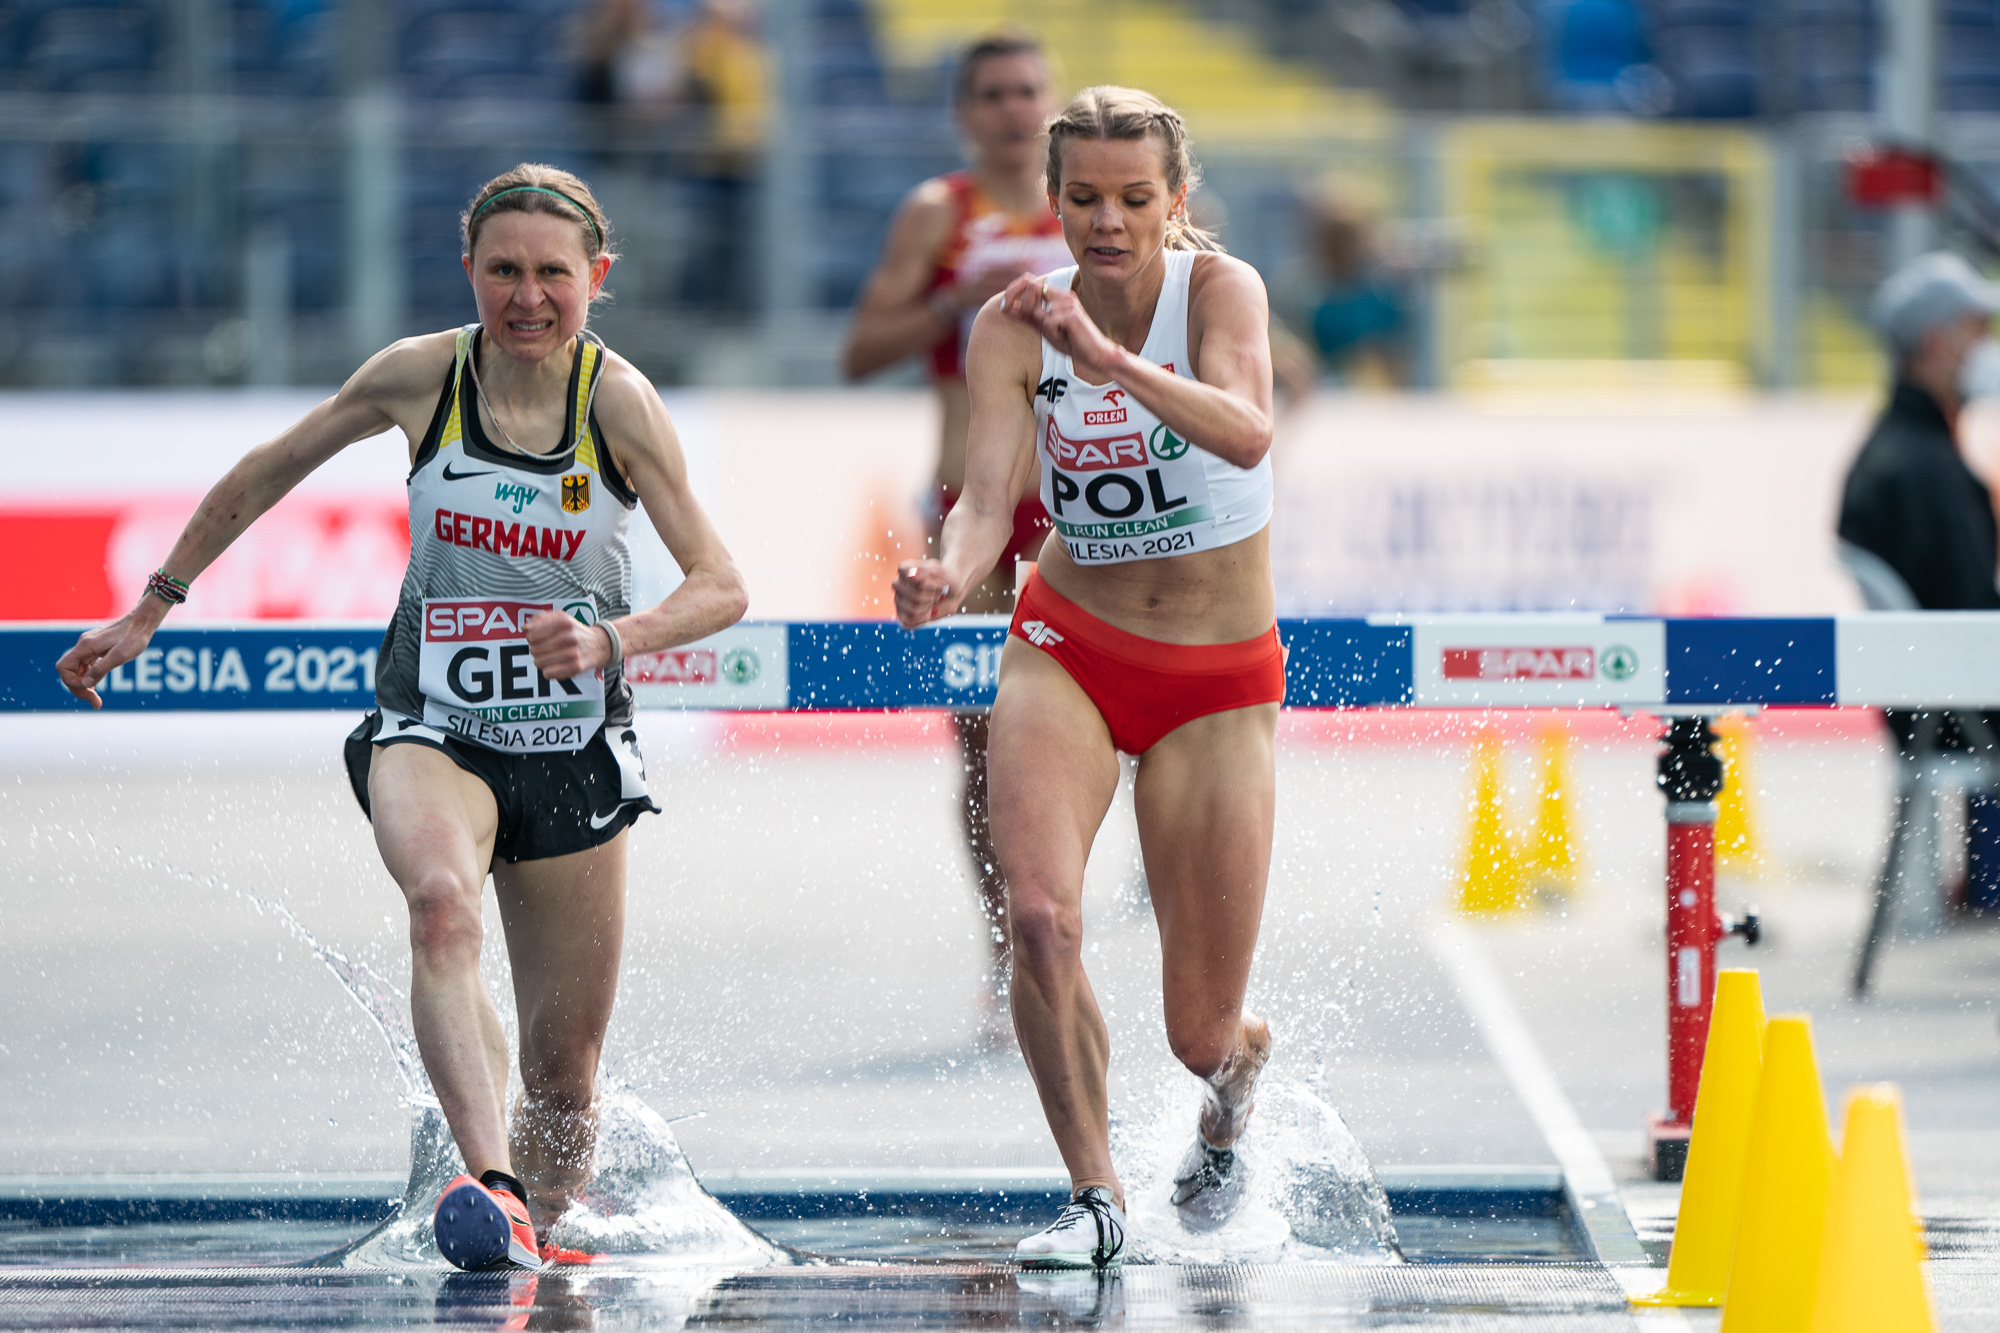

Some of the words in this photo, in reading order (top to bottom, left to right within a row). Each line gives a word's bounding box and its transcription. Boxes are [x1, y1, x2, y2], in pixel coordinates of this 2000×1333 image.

[1036, 376, 1068, 404] 4F
[1086, 409, 1125, 425] ORLEN
[1047, 420, 1144, 468] SPAR
[1052, 466, 1188, 519] POL
[435, 507, 587, 562] GERMANY
[1066, 523, 1071, 536] I
[1074, 524, 1109, 538] RUN
[1064, 541, 1138, 561] ILESIA
[1142, 531, 1195, 556] 2021
[1021, 620, 1065, 647] 4F
[263, 646, 377, 692] 2021
[627, 652, 714, 683] PAR
[1478, 650, 1592, 679] SPAR
[447, 714, 526, 747] SILESIA
[531, 725, 583, 746] 2021
